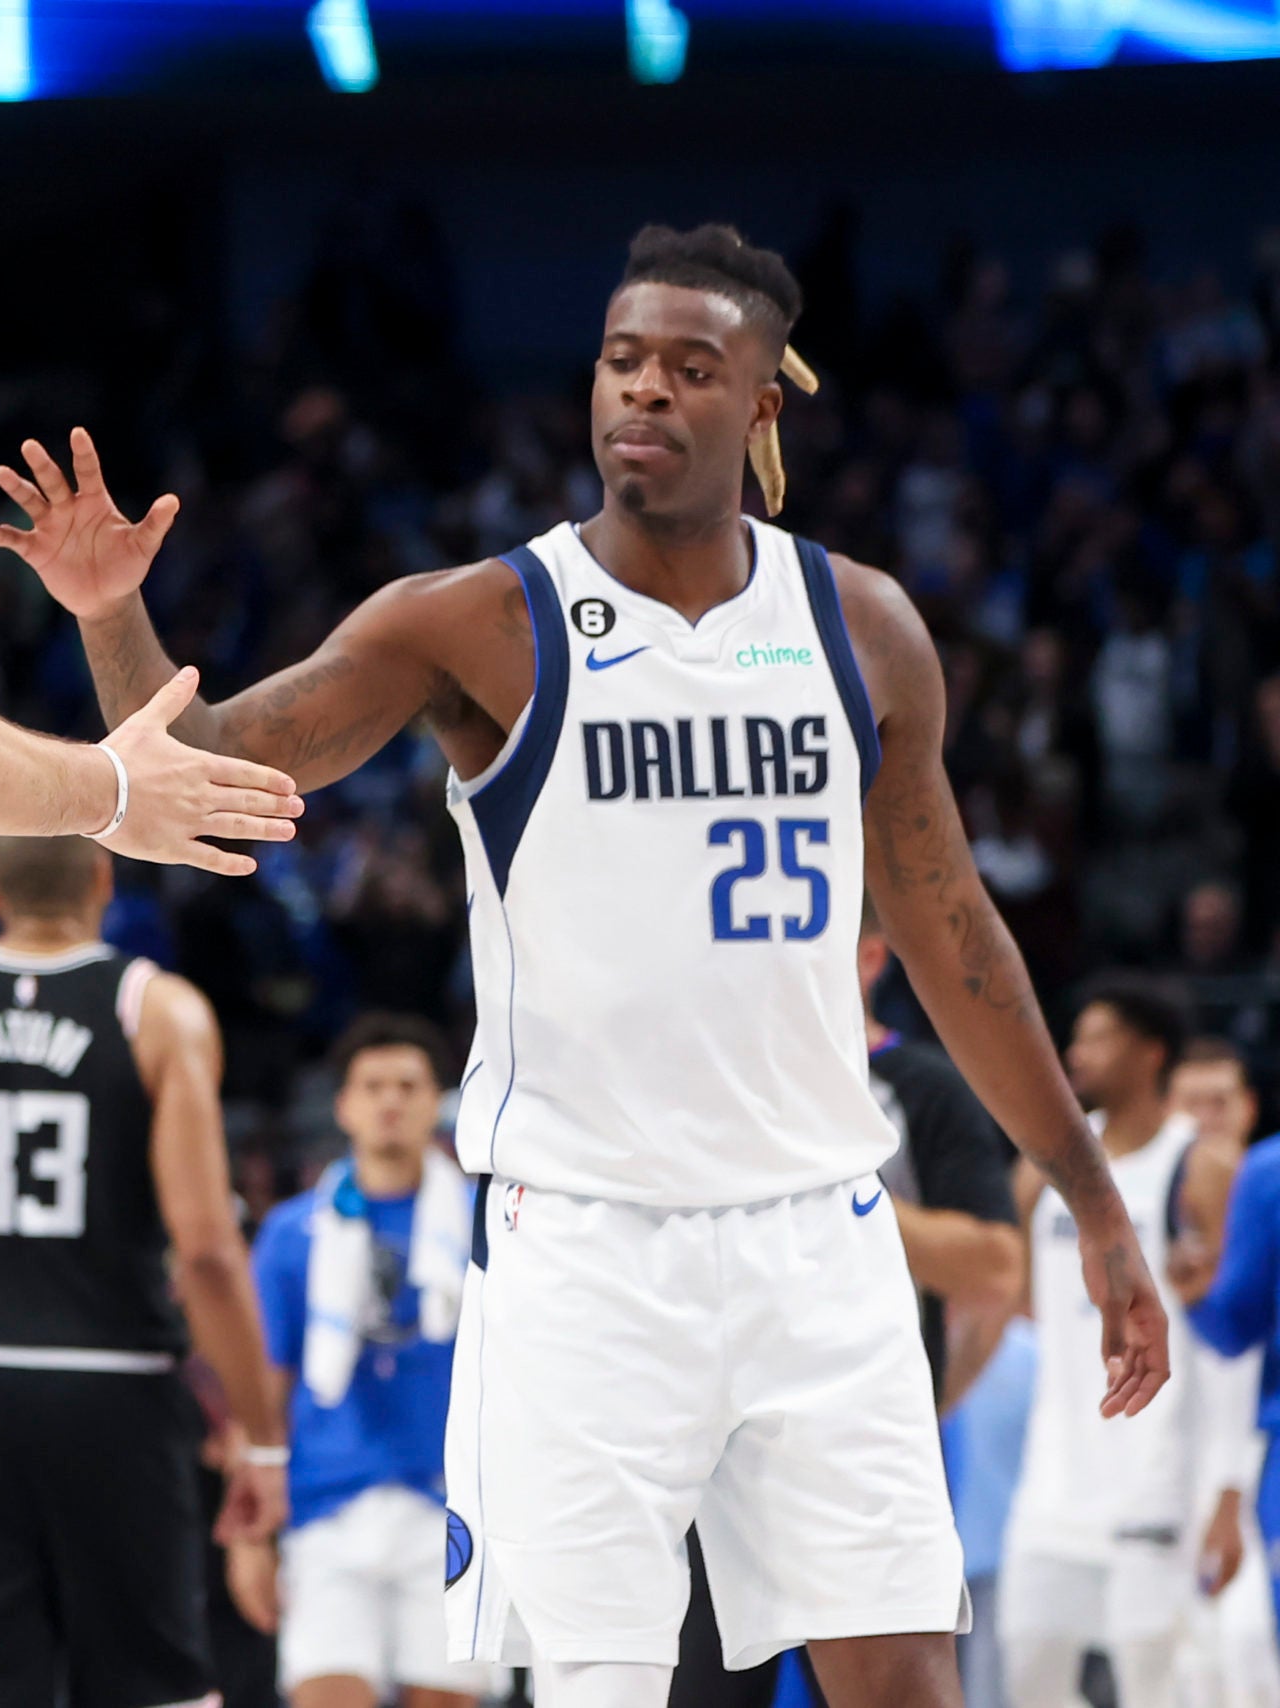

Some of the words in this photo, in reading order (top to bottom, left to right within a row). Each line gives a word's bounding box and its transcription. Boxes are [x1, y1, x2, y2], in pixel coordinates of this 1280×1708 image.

[579, 602, 606, 634] 6
[736, 643, 813, 667] chime
[580, 714, 829, 802] DALLAS
[707, 816, 831, 943] 25
